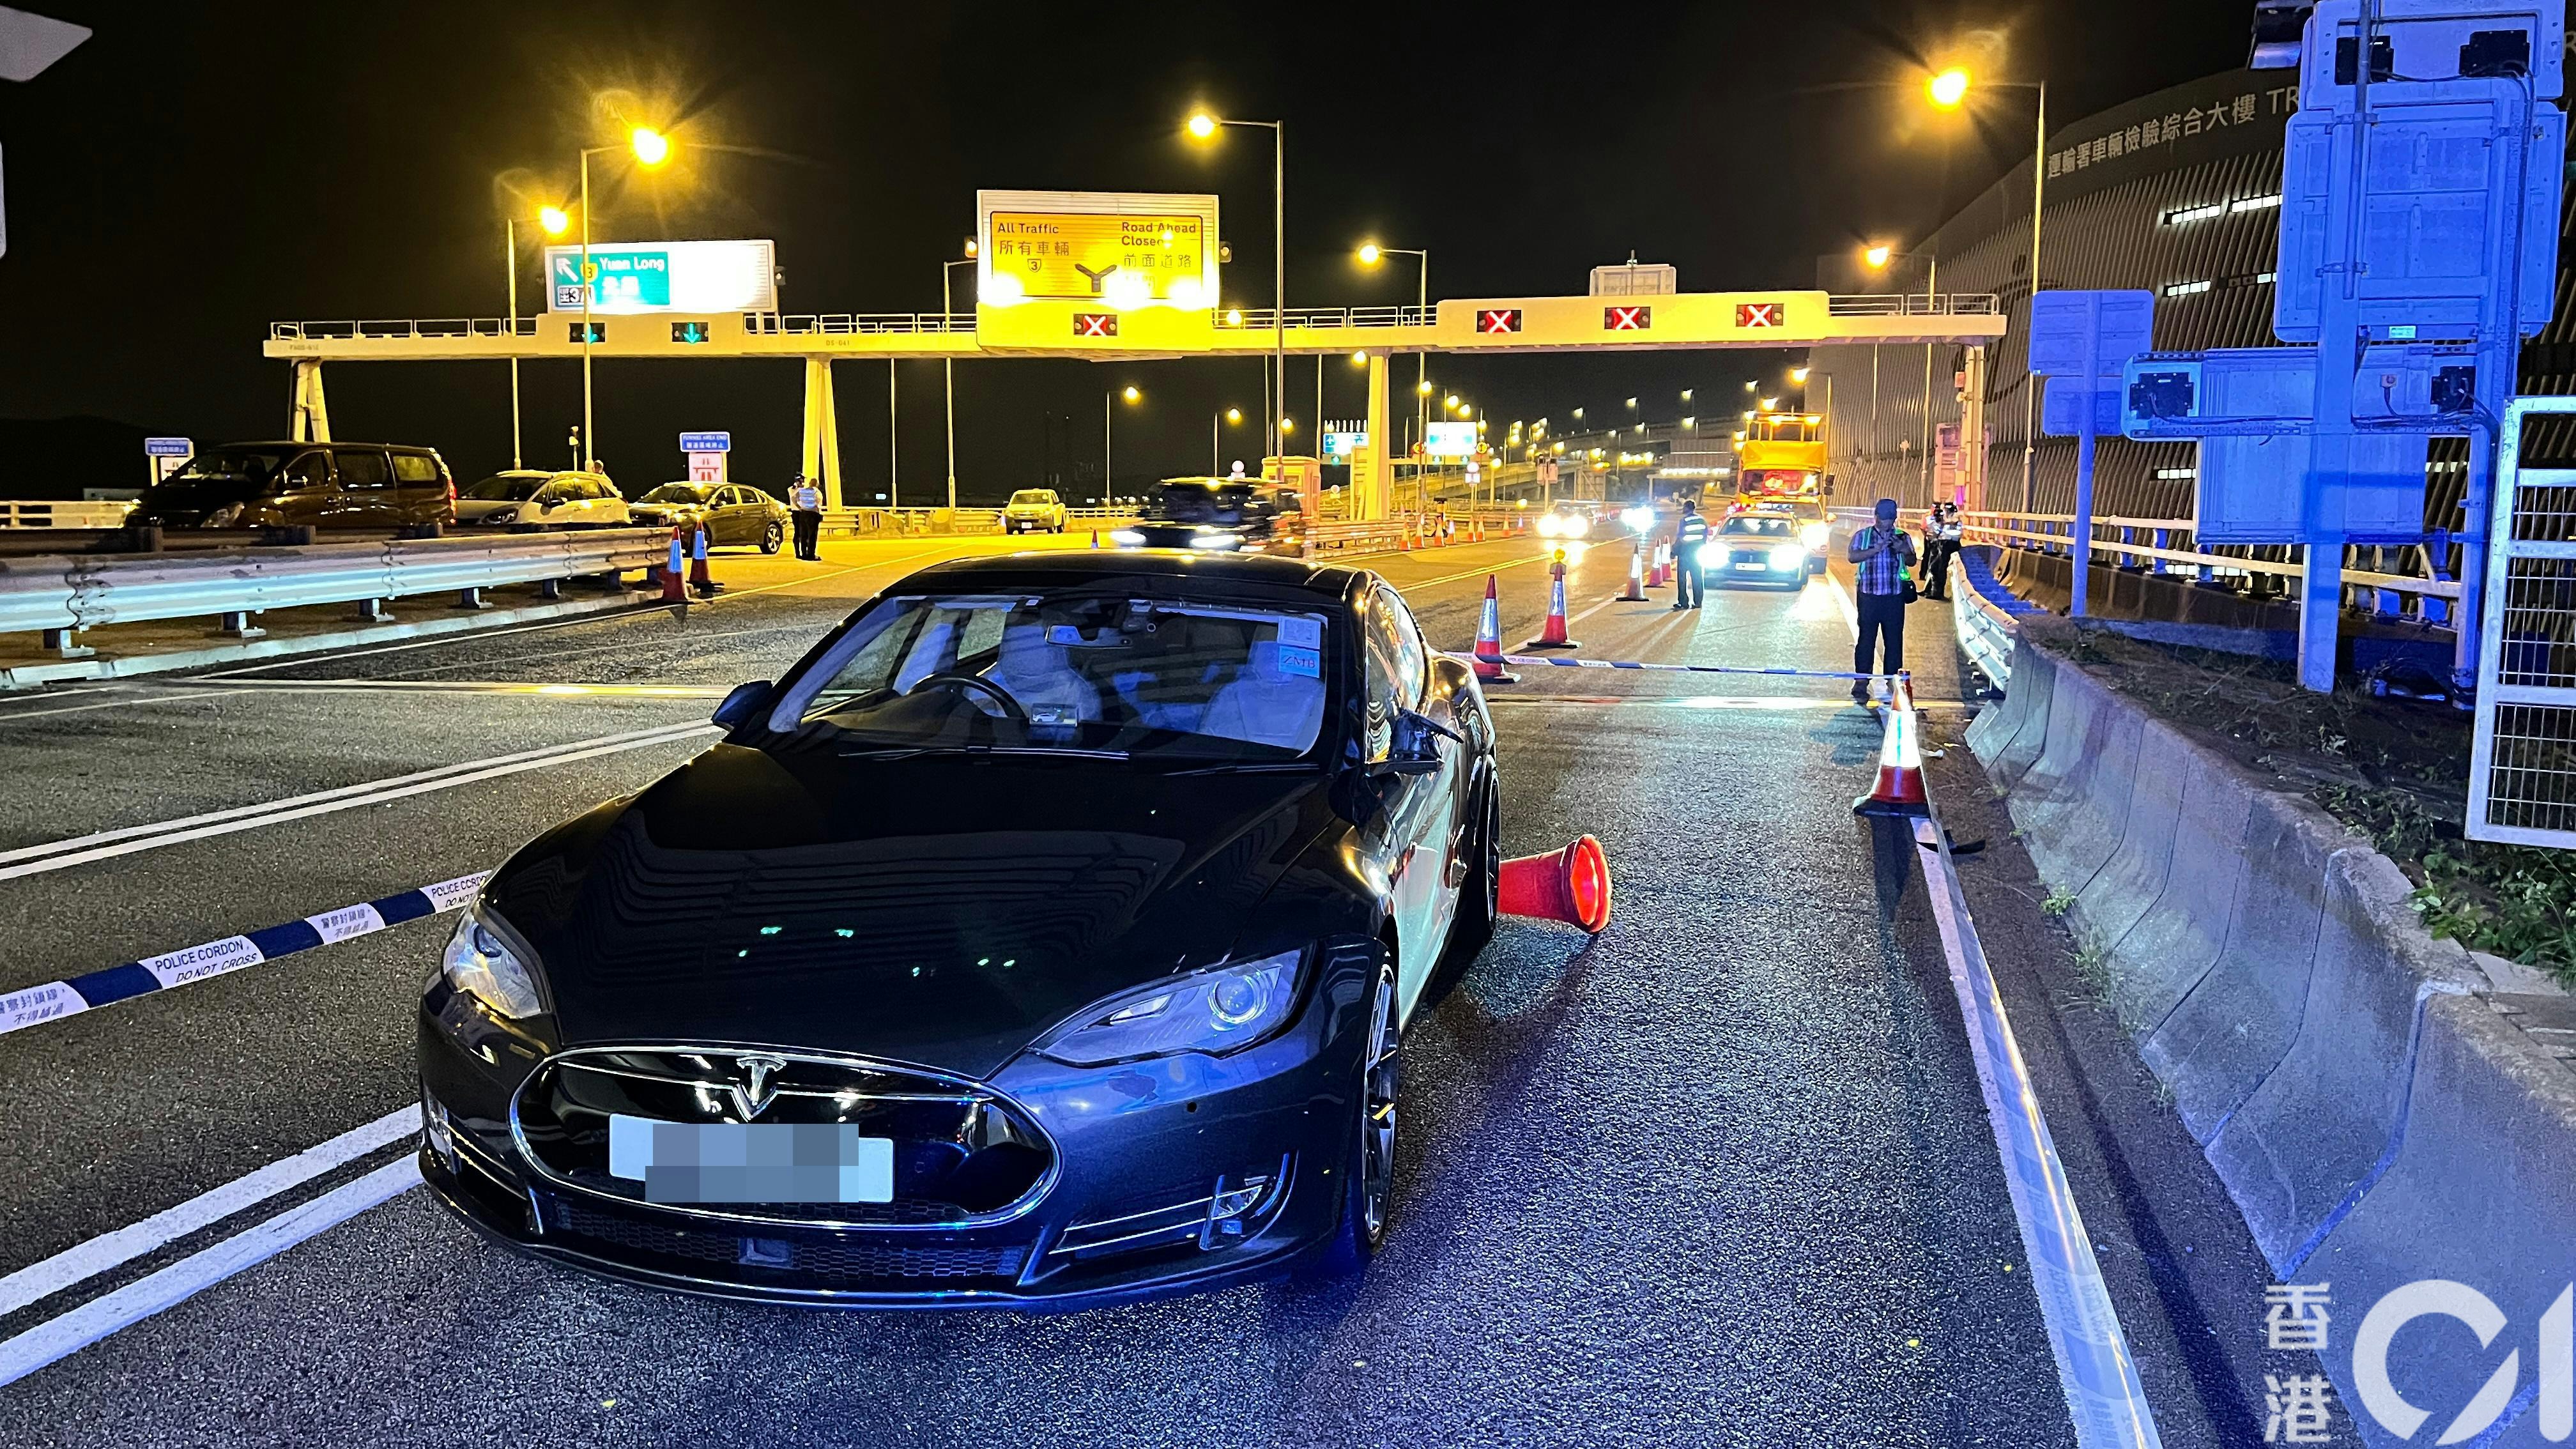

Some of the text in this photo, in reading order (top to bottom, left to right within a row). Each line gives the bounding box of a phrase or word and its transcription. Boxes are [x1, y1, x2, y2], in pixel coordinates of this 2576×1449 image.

[2048, 94, 2256, 179] 運輸署車輛檢驗綜合大樓
[997, 222, 1059, 234] All Traffic
[1122, 222, 1196, 233] Road Ahead
[999, 240, 1070, 256] 所有車輛
[599, 256, 665, 272] Yuan Long
[1031, 261, 1038, 270] 3
[1124, 253, 1192, 268] 前面道路
[586, 267, 593, 279] 3
[431, 882, 460, 898] POLICE
[155, 951, 197, 972] POLICE
[194, 963, 217, 978] NOT
[221, 953, 257, 970] CROSS
